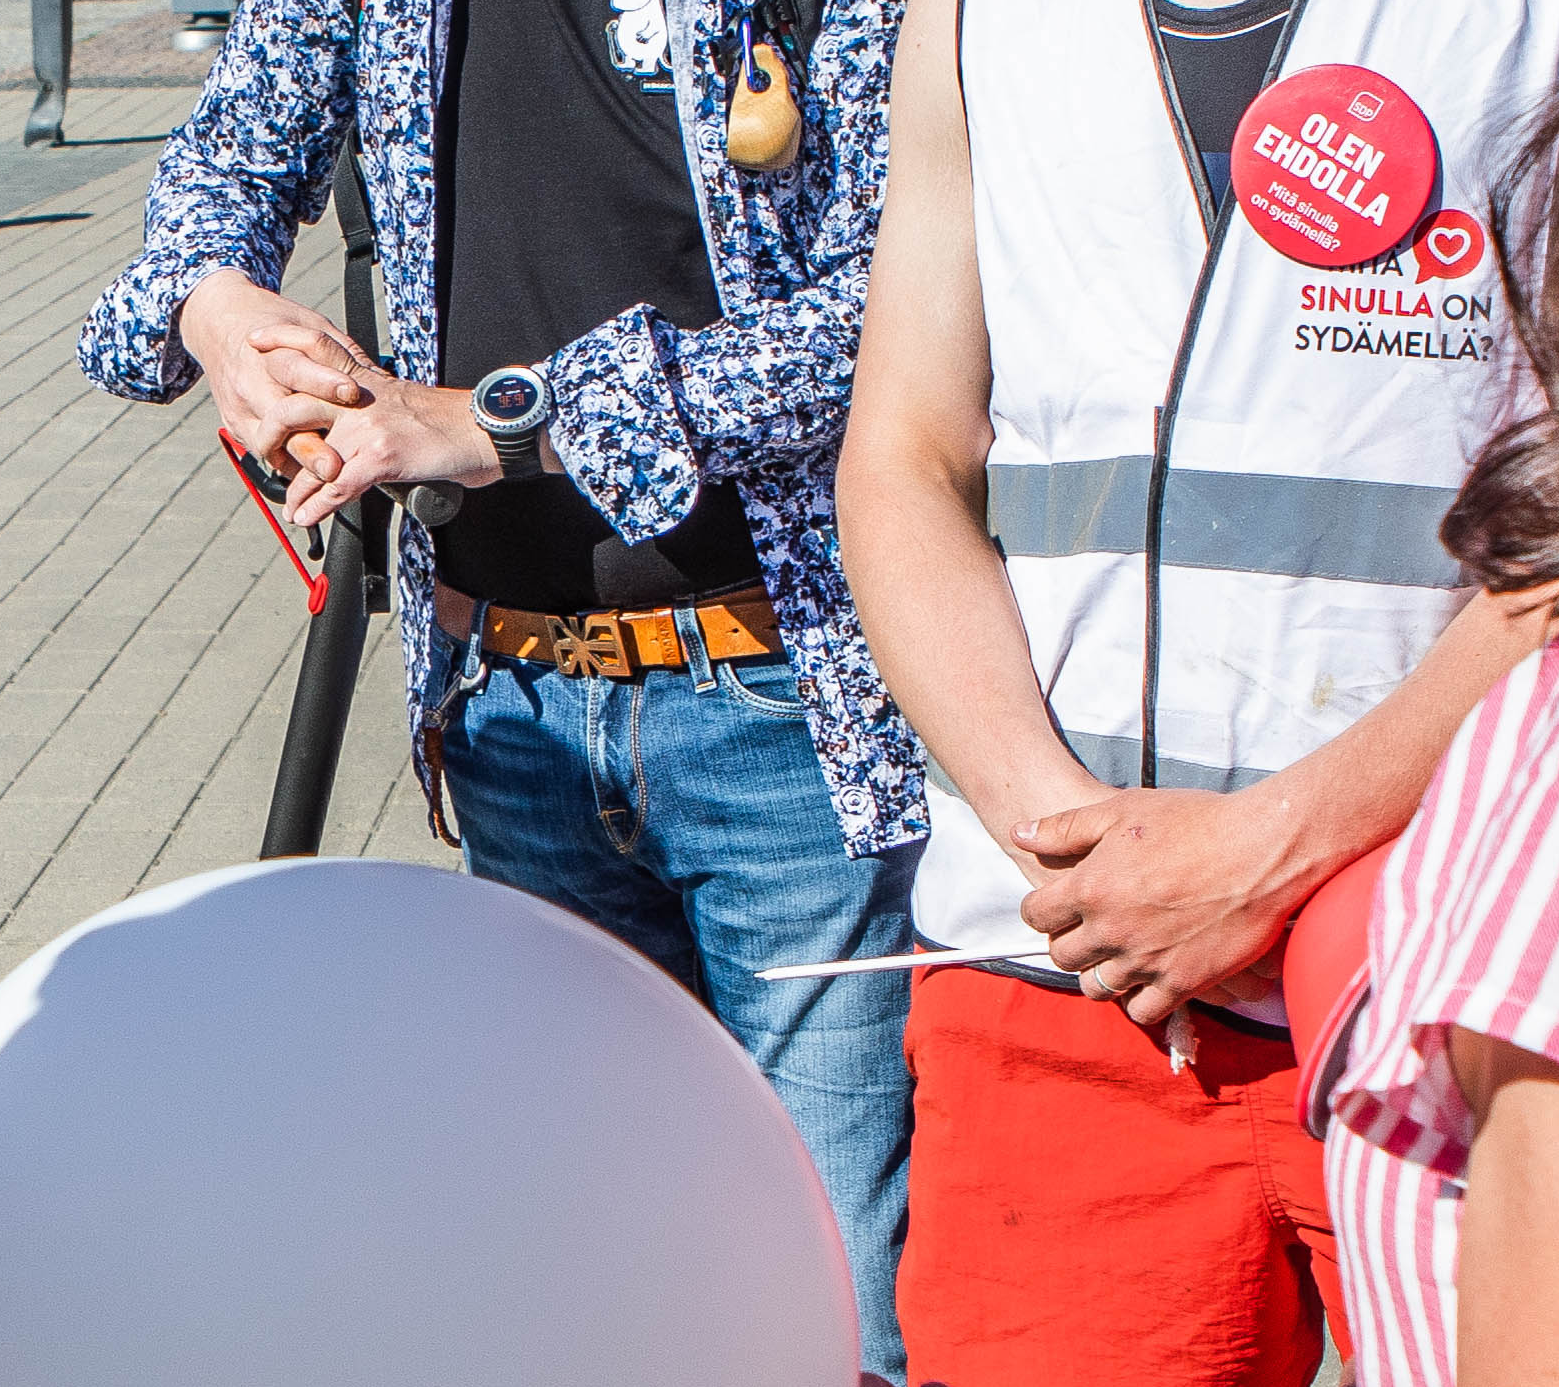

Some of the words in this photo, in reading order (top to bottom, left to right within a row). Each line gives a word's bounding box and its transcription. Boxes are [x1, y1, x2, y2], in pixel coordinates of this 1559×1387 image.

[1353, 102, 1374, 118] SDP
[1300, 113, 1386, 181] OLEN
[1253, 123, 1391, 228] EHDOLLA
[1250, 193, 1269, 211] on
[1268, 204, 1342, 254] sydämellä?
[1267, 181, 1300, 209] Mitä
[1296, 202, 1340, 234] sinulla
[1300, 285, 1435, 319] SINULLA
[1442, 294, 1492, 322] ON
[1294, 320, 1495, 362] SYDÄMELLÄ?
